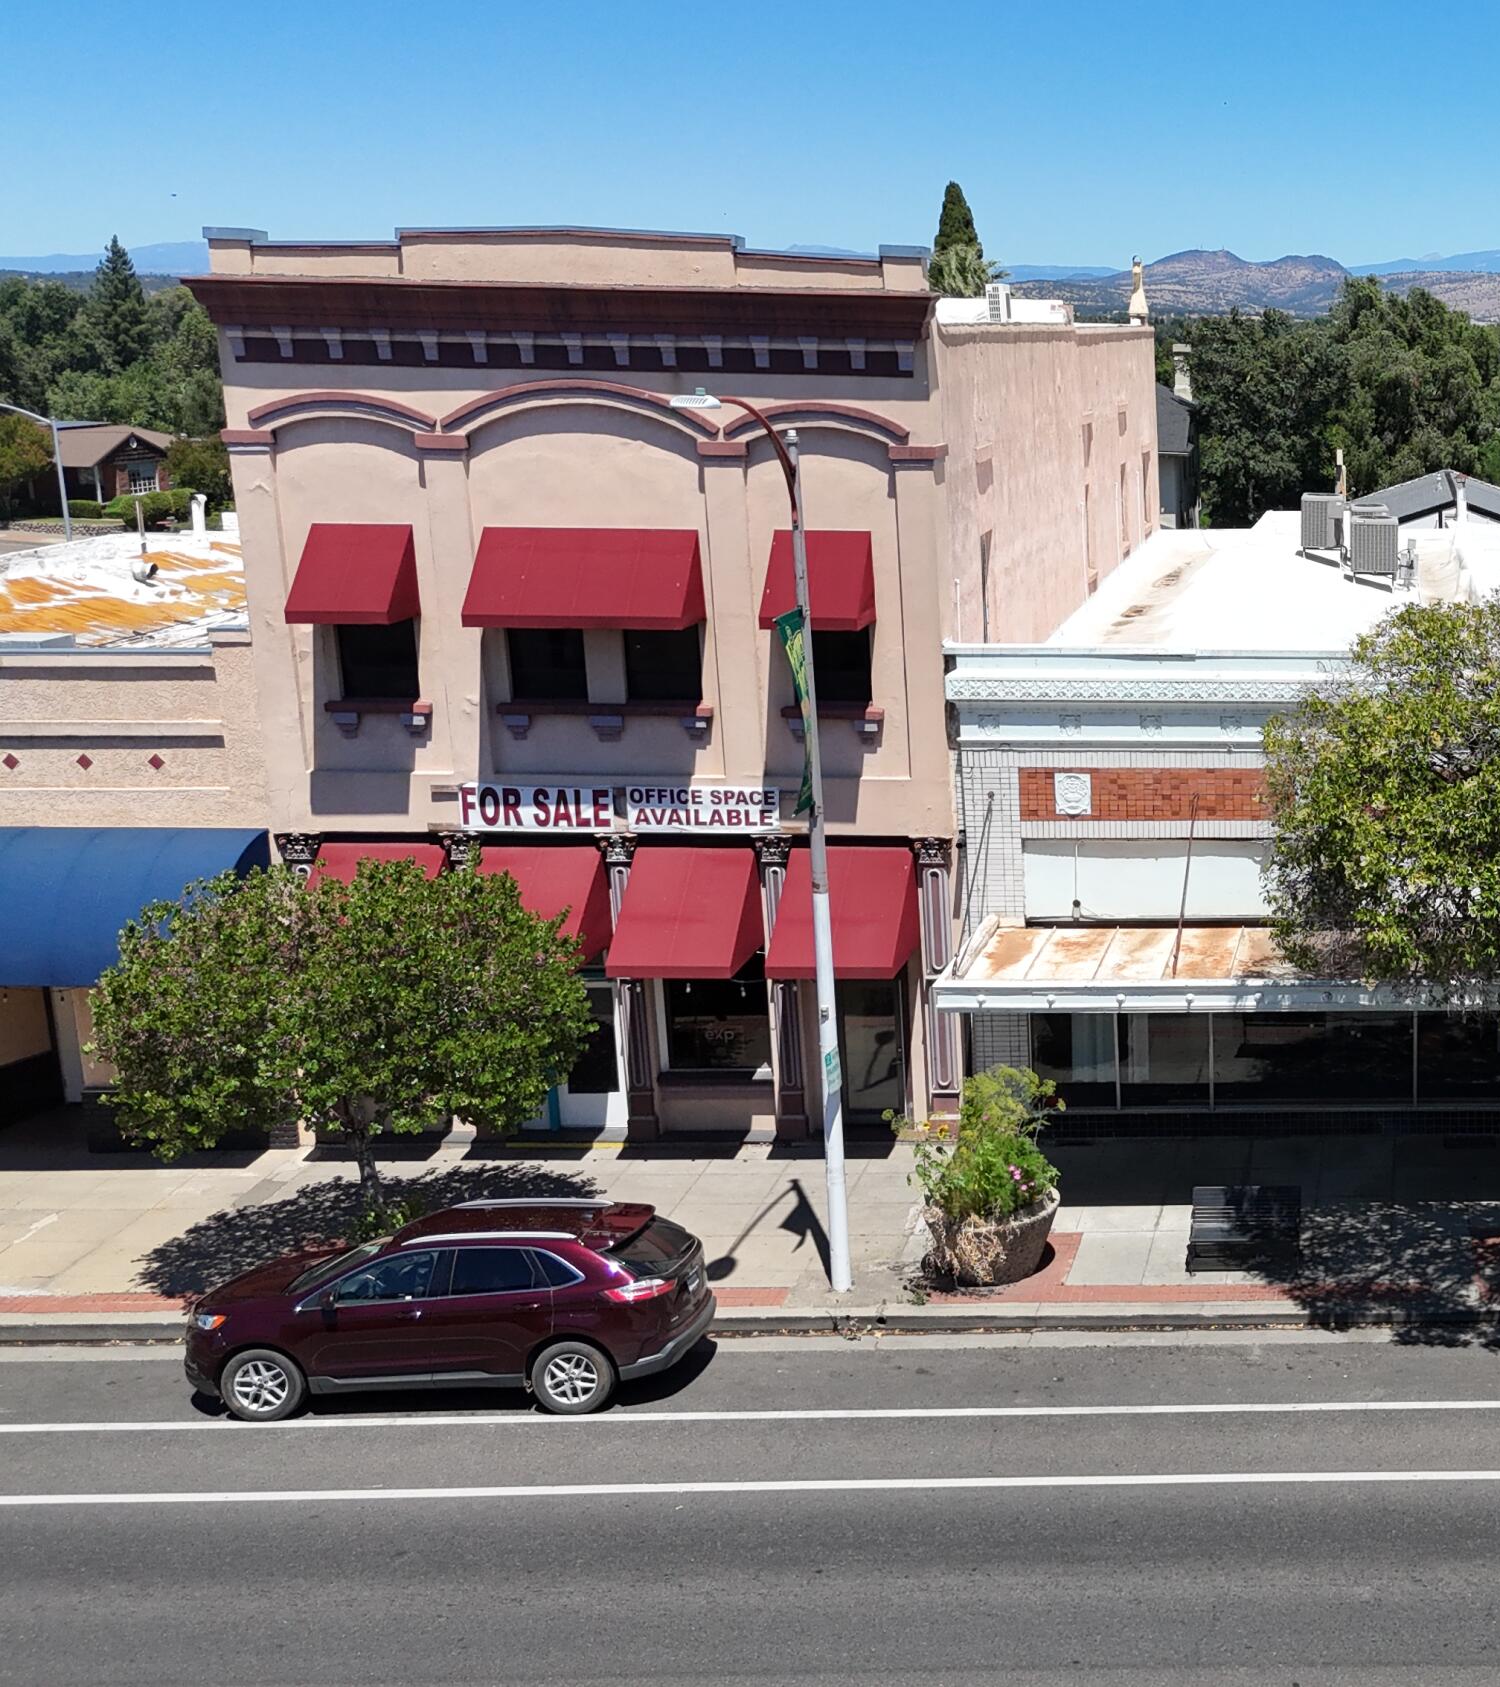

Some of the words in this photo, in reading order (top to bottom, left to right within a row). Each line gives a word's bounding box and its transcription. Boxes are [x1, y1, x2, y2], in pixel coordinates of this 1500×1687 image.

[629, 788, 703, 805] OFFICE
[710, 790, 776, 806] SPACE
[461, 787, 523, 826] FOR
[533, 788, 612, 827] SALE
[634, 808, 774, 826] AVAILABLE
